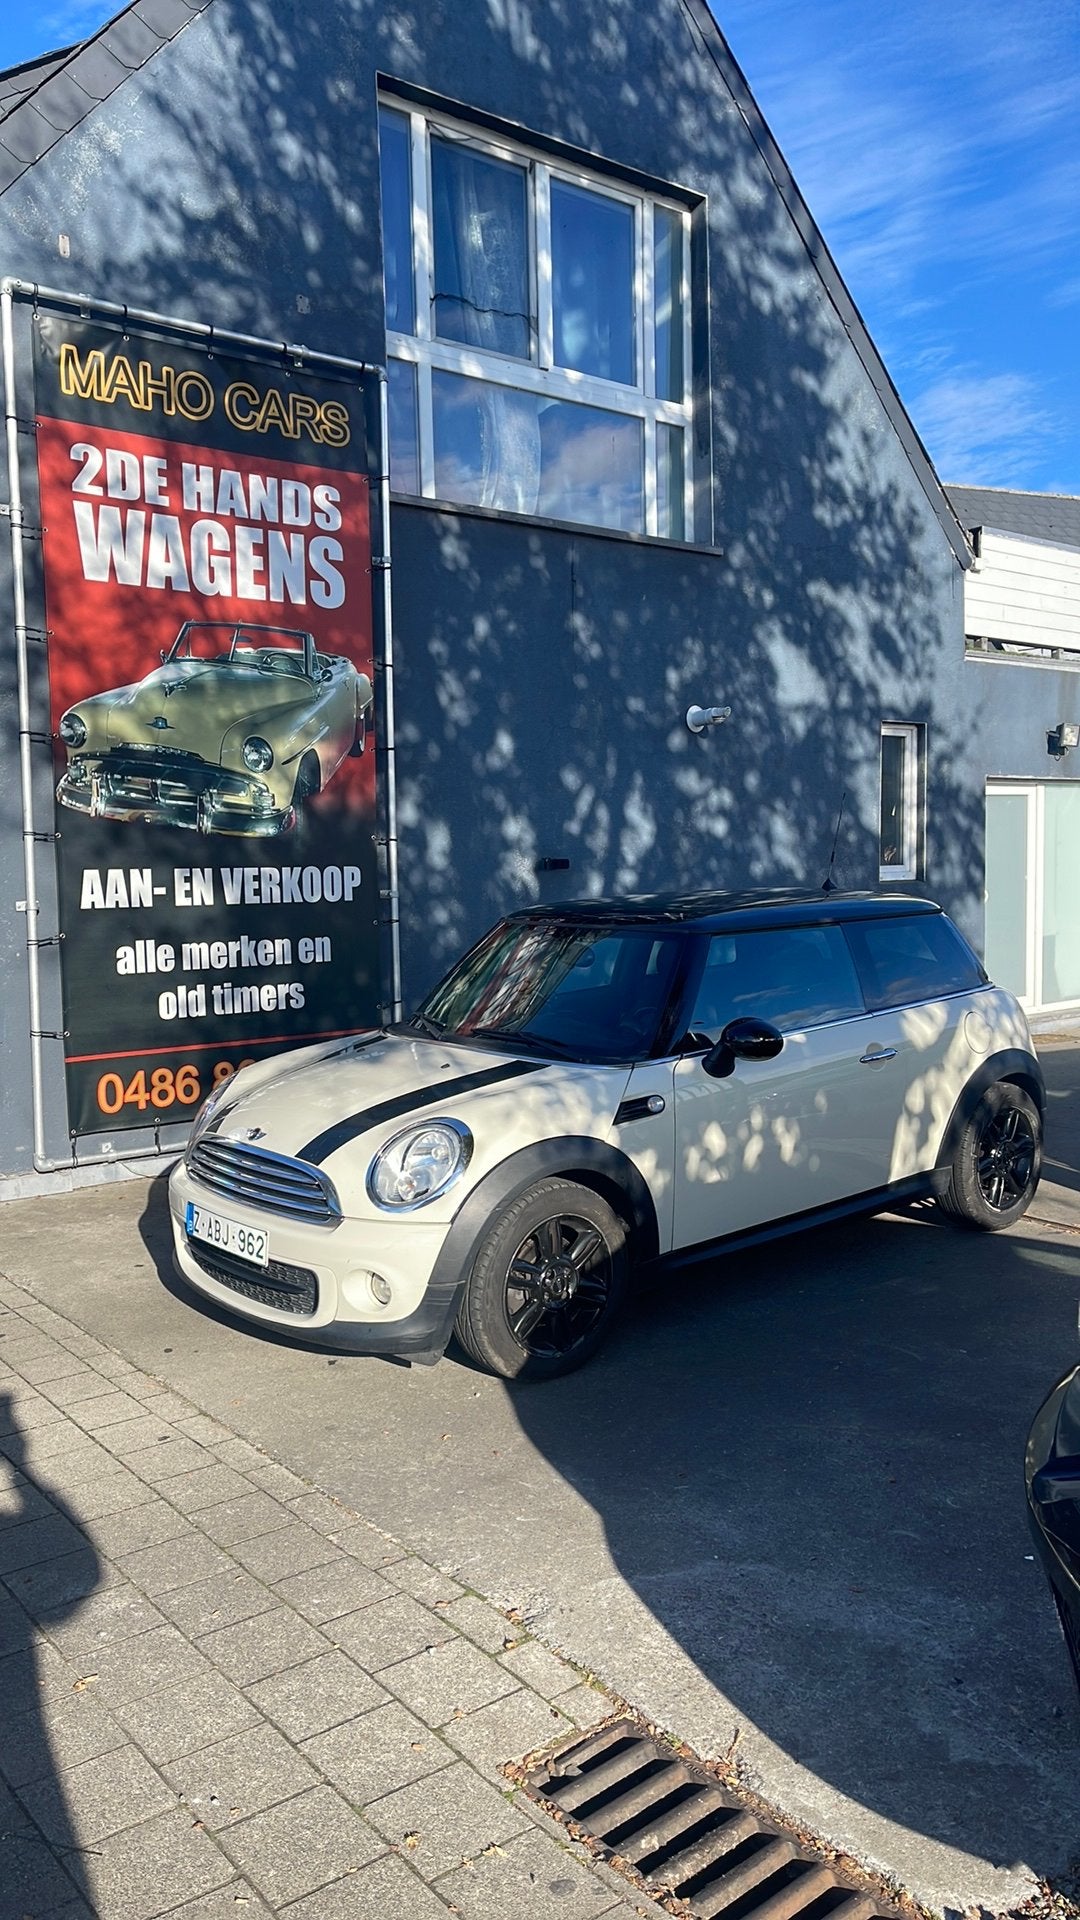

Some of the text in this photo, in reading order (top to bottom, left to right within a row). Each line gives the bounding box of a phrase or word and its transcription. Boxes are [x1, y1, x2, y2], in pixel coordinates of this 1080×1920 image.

[59, 343, 351, 448] MAHO CARS
[69, 442, 343, 532] 2DE HANDS
[72, 500, 346, 609] WAGENS
[80, 865, 362, 909] AAN- EN VERKOOP
[116, 935, 332, 975] alle merken en
[158, 982, 306, 1020] old timers
[97, 1063, 201, 1115] 0486
